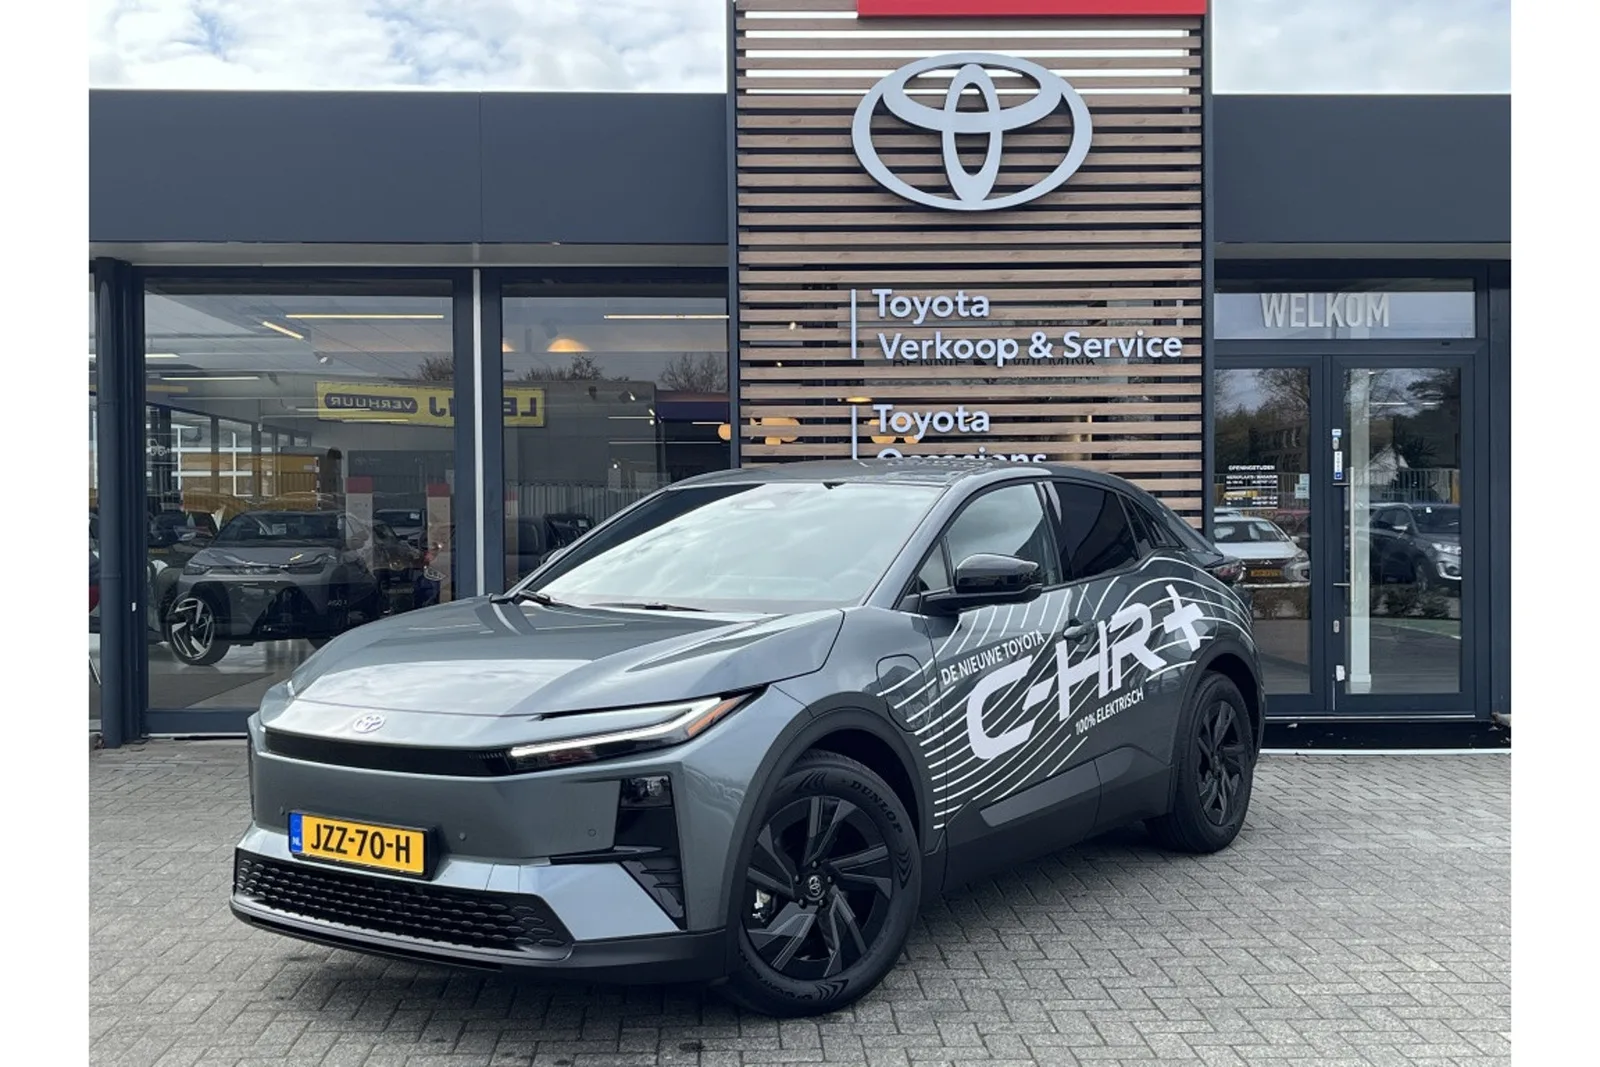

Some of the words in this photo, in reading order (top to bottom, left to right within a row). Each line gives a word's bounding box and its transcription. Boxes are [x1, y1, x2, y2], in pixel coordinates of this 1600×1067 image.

[872, 288, 991, 325] Toyota
[1260, 292, 1390, 328] WELKOM
[878, 331, 1019, 367] Verkoop
[1028, 331, 1053, 358] &
[1062, 329, 1183, 358] Service
[872, 404, 991, 440] Toyota
[940, 664, 959, 686] DE
[958, 645, 1004, 678] NIEUWE
[1001, 629, 1045, 658] TOYOTA
[1075, 712, 1096, 736] 100%
[1096, 686, 1144, 724] ELEKTRISCH
[850, 780, 904, 834] DUNLOP
[310, 823, 410, 863] JZZ-70-H
